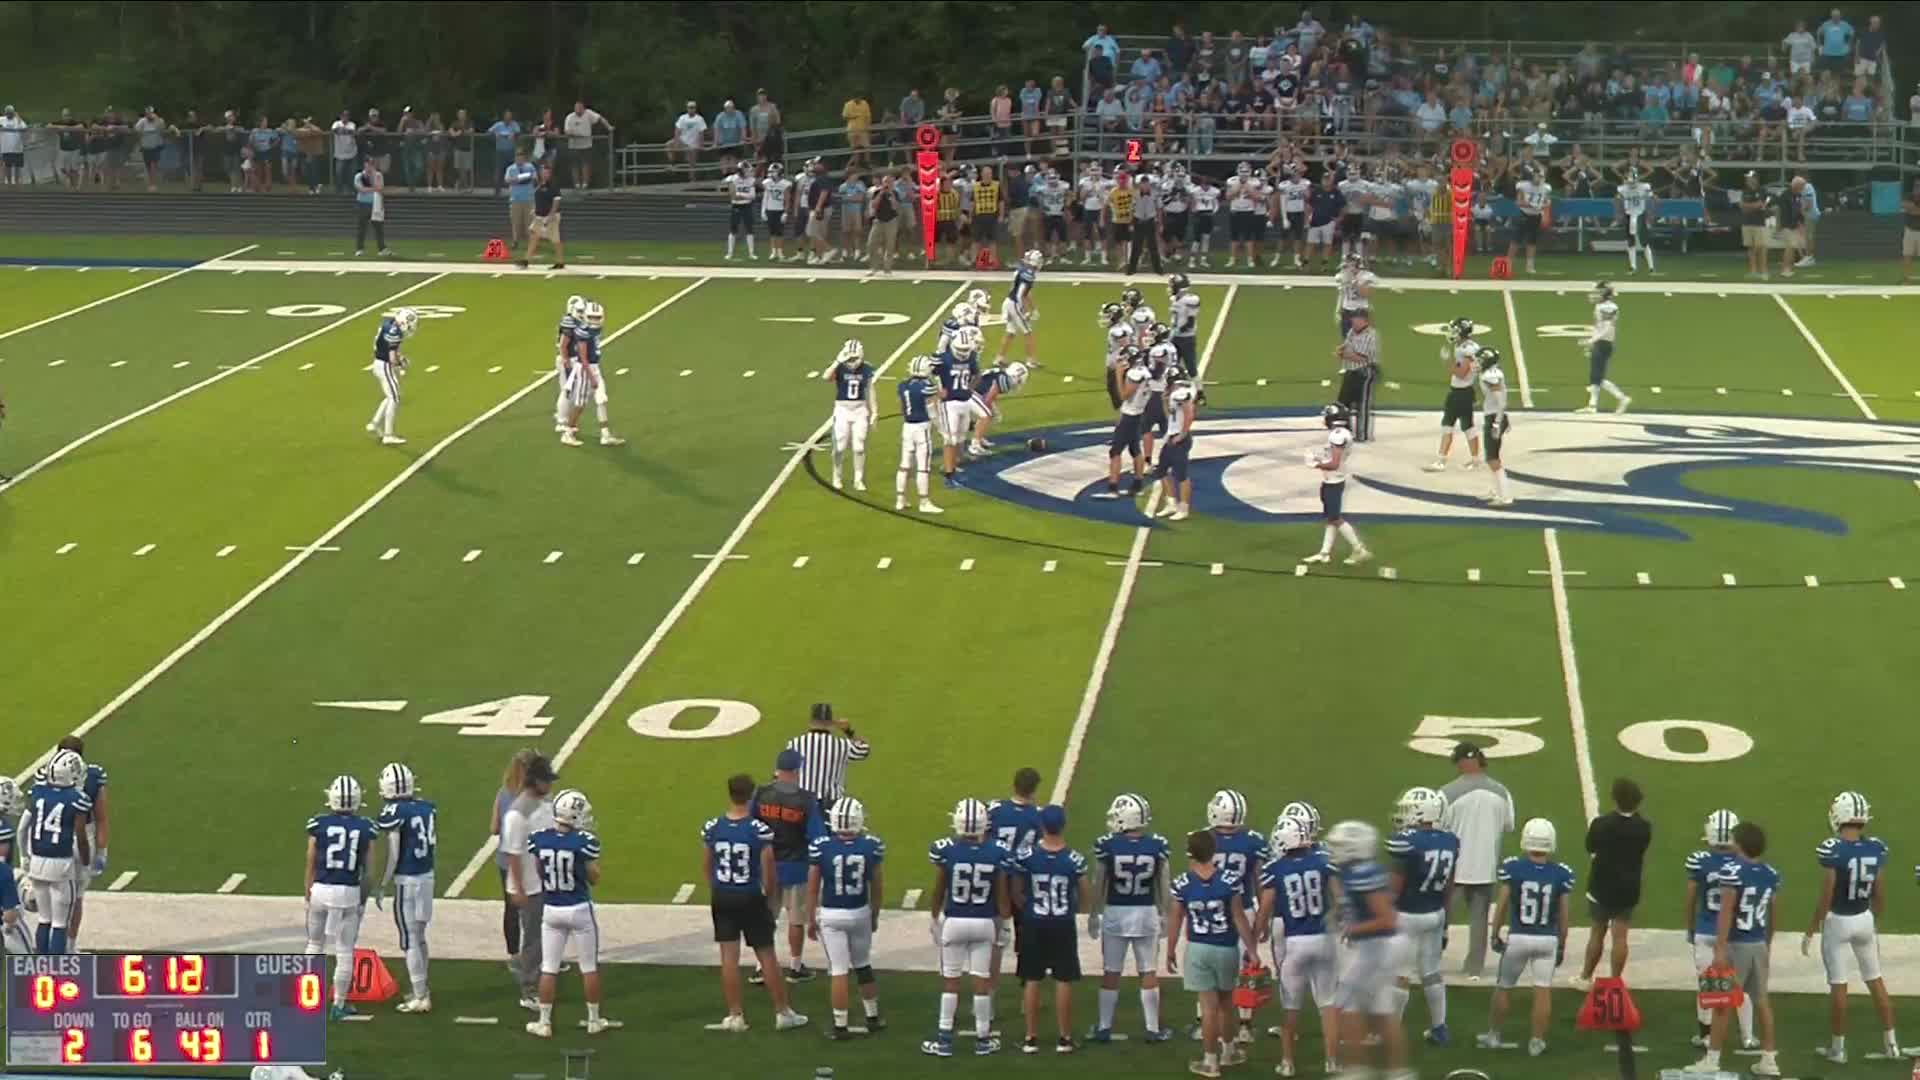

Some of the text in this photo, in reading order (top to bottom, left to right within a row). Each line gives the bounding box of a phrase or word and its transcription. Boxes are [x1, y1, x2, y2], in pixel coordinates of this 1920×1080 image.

[1127, 140, 1141, 161] 2
[847, 379, 860, 400] 0
[950, 369, 970, 390] 70
[903, 389, 913, 416] 1
[34, 798, 65, 844] 14
[410, 813, 436, 859] 34
[326, 826, 361, 871] 21
[715, 841, 750, 883] 33
[539, 849, 575, 892] 30
[832, 855, 865, 896] 13
[952, 862, 994, 904] 65
[1114, 855, 1155, 896] 52
[1420, 849, 1453, 892] 73
[1847, 857, 1878, 900] 15
[1031, 874, 1068, 916] 50
[1284, 869, 1323, 918] 88
[1520, 881, 1552, 925] 61
[1592, 988, 1624, 1025] 50
